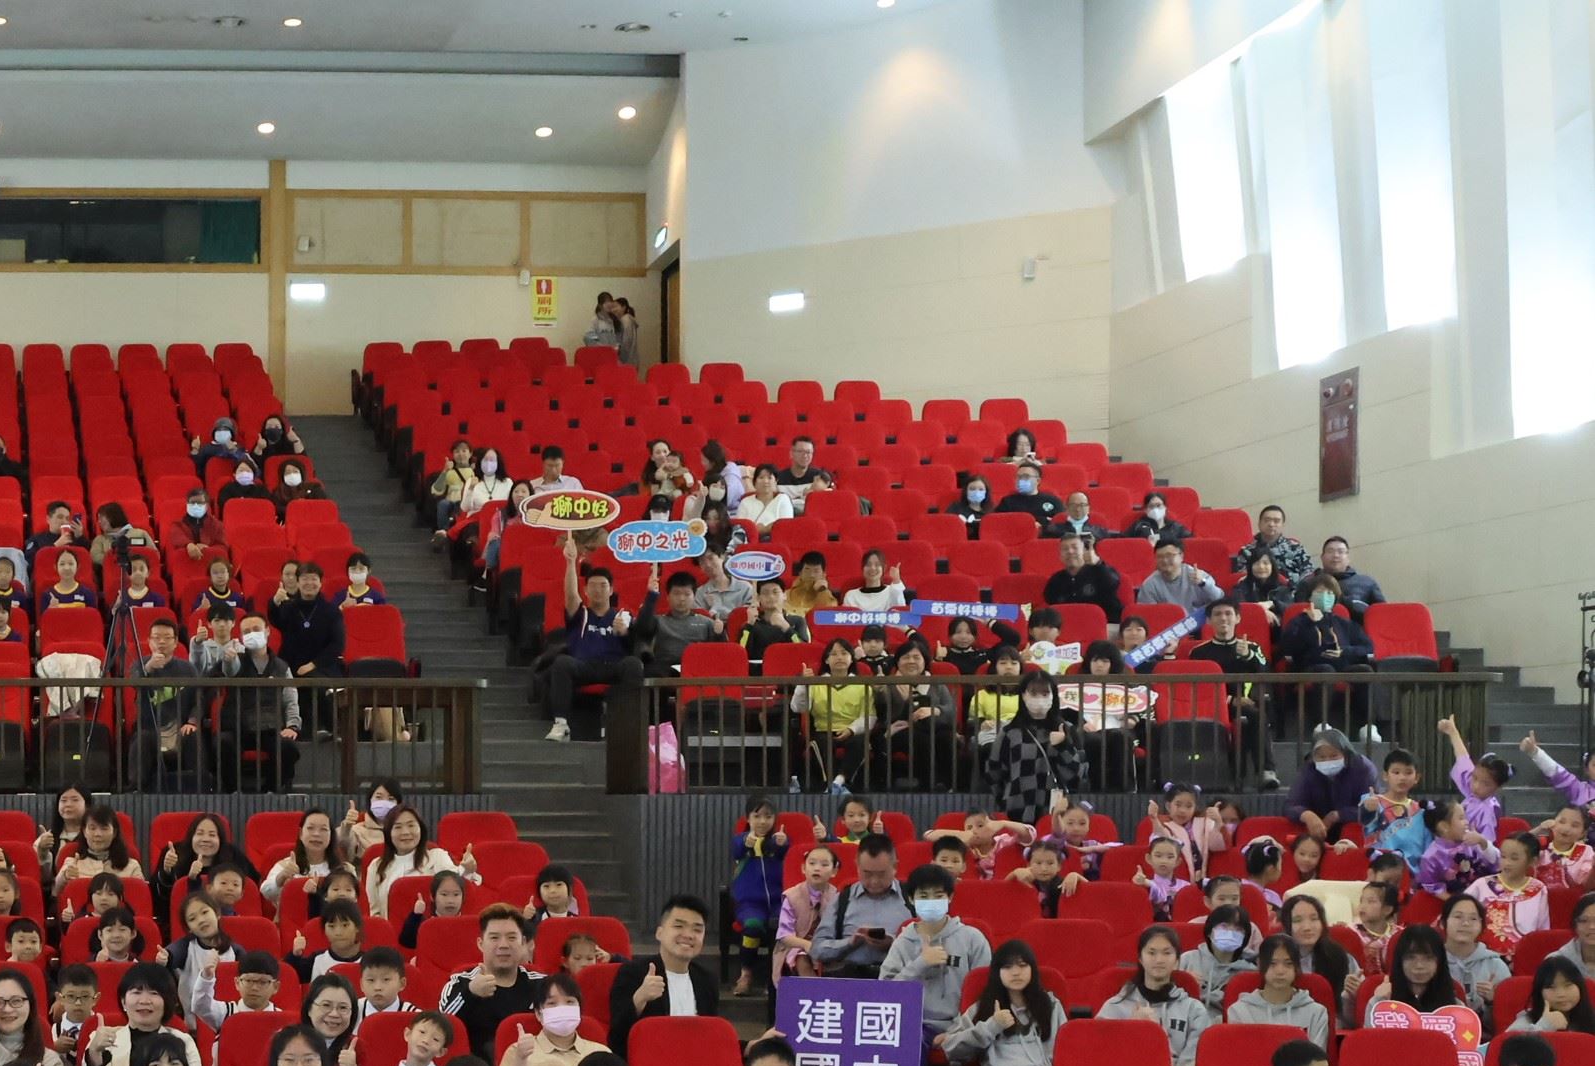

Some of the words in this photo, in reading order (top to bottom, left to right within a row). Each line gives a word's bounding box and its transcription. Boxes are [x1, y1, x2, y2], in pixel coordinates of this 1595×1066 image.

[552, 495, 608, 518] 獅中好
[617, 532, 689, 551] 獅中之光
[795, 998, 902, 1047] 建國
